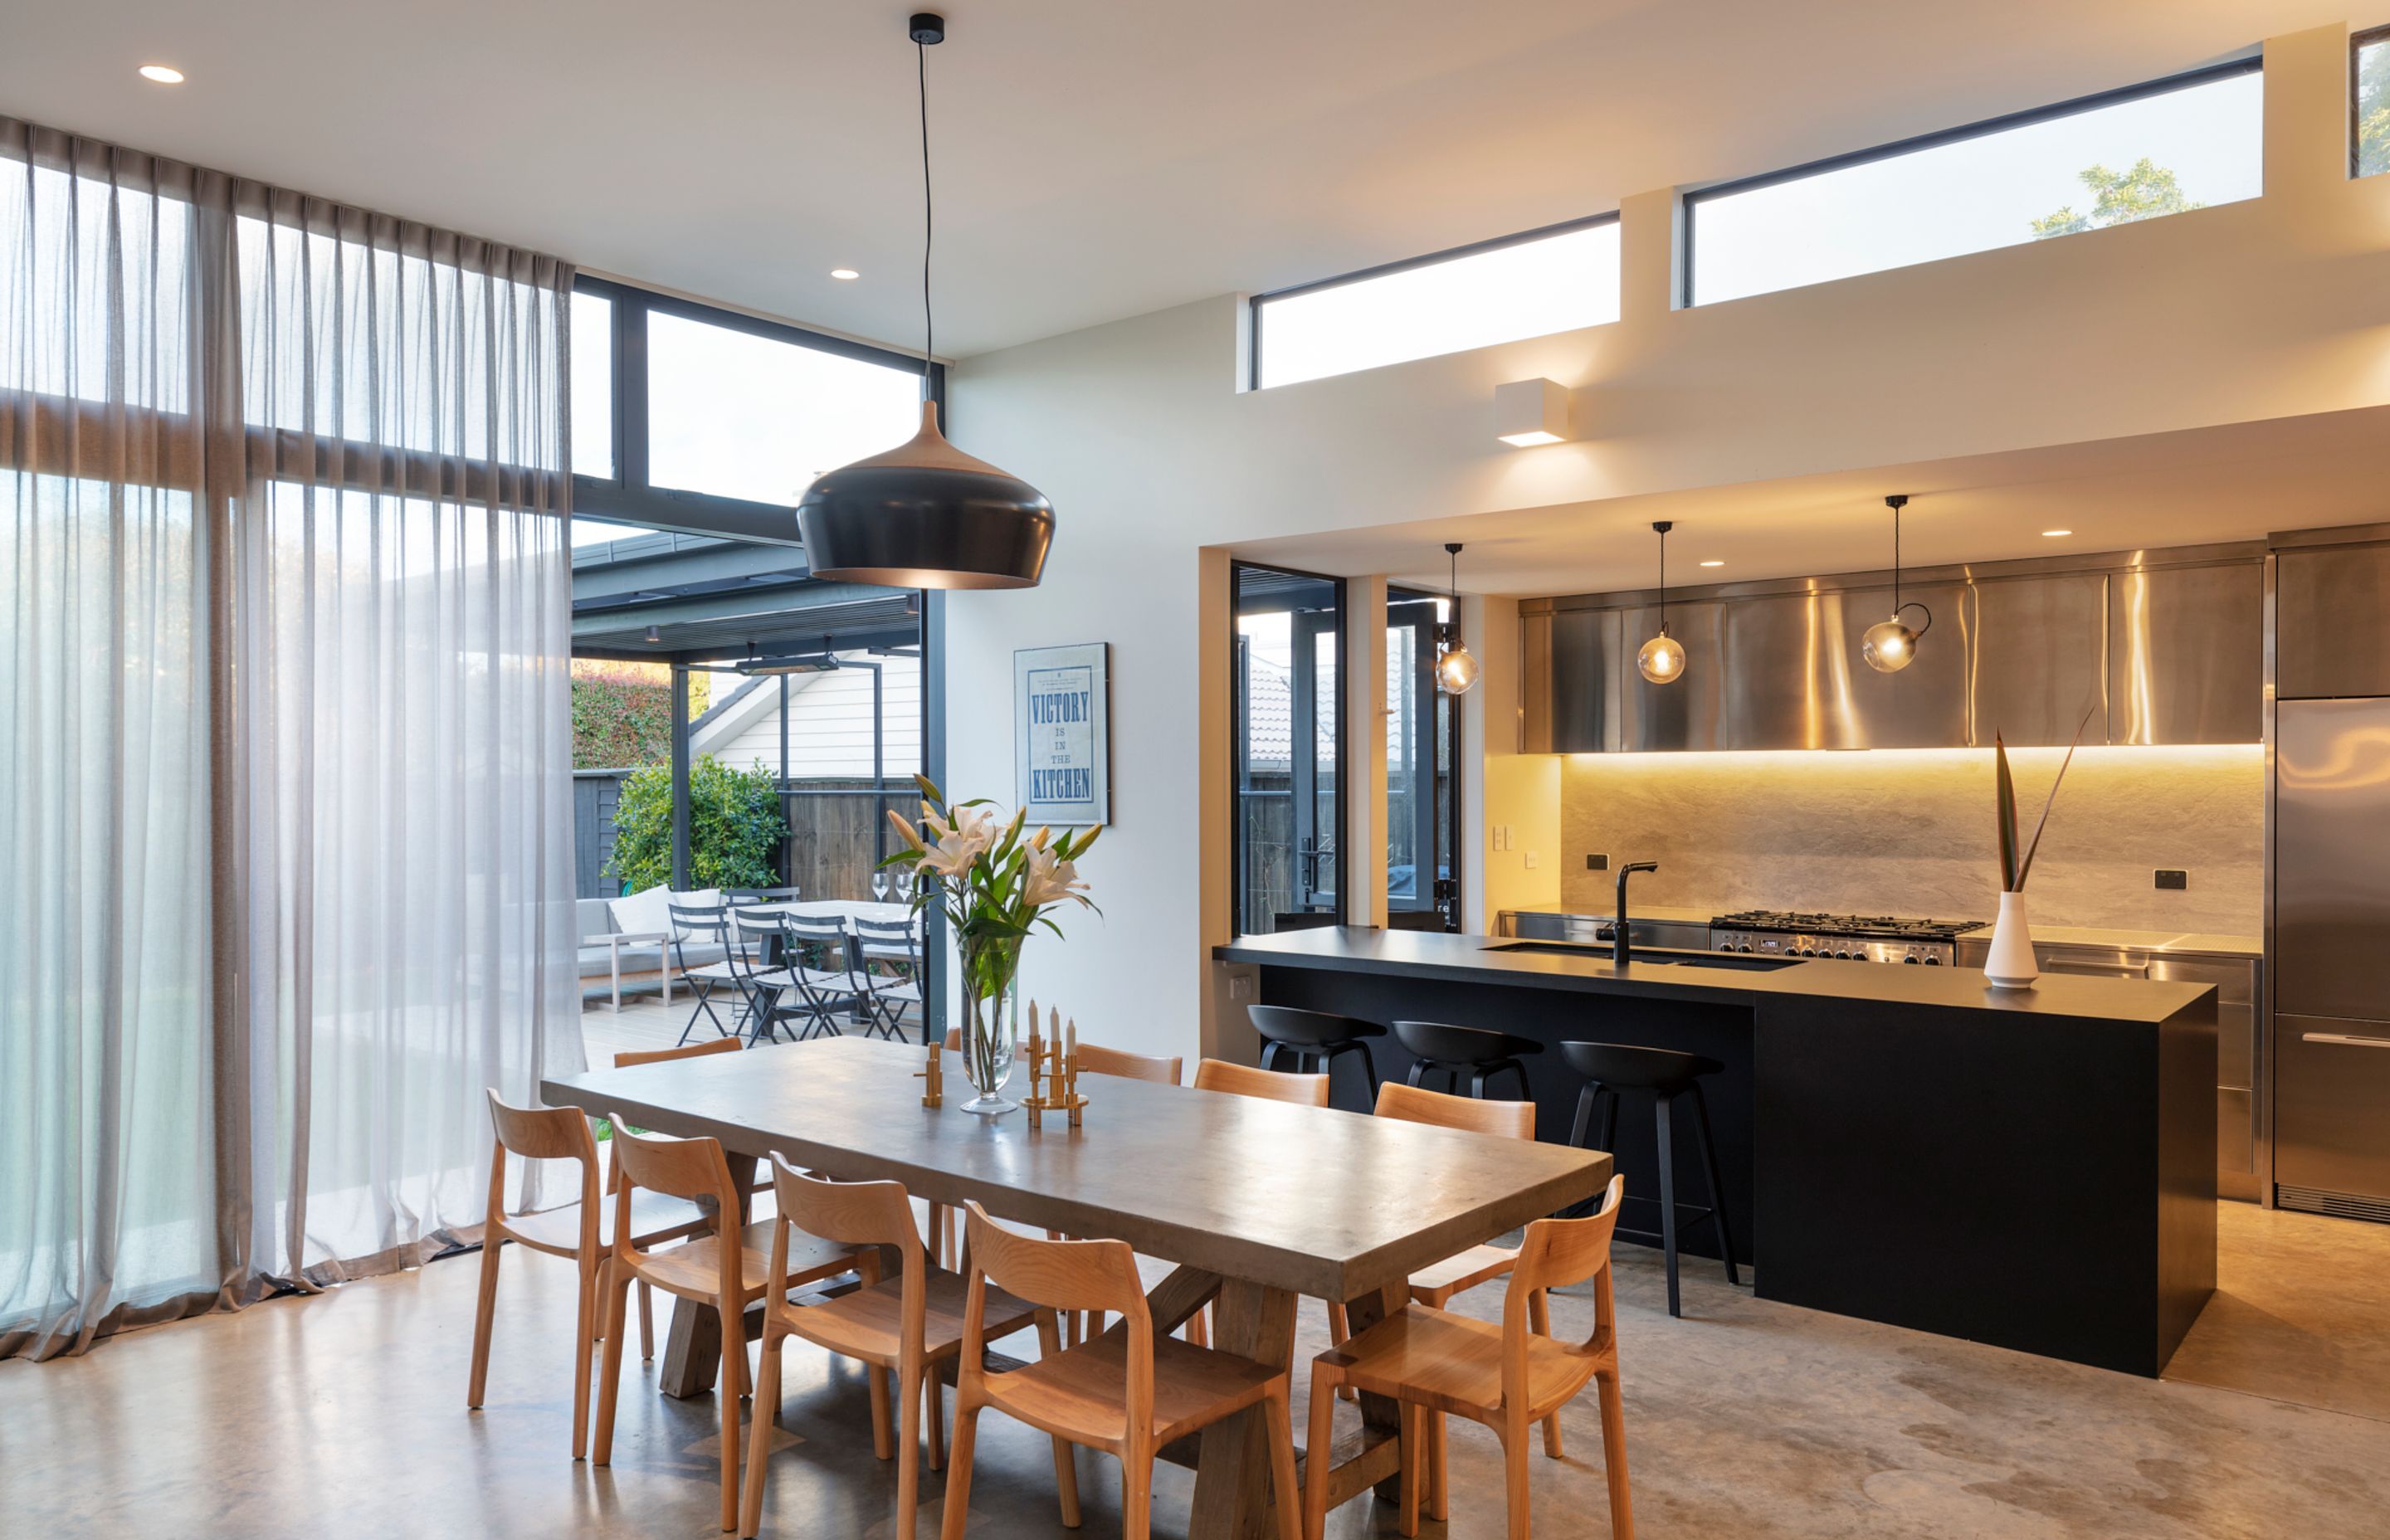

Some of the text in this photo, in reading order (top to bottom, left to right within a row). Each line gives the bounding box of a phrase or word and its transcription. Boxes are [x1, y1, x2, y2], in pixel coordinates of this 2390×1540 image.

[1032, 691, 1089, 724] VICTORY
[1056, 728, 1066, 737] IS
[1055, 741, 1066, 750] IN
[1051, 755, 1071, 764] THE
[1032, 768, 1090, 799] KITCHEN
